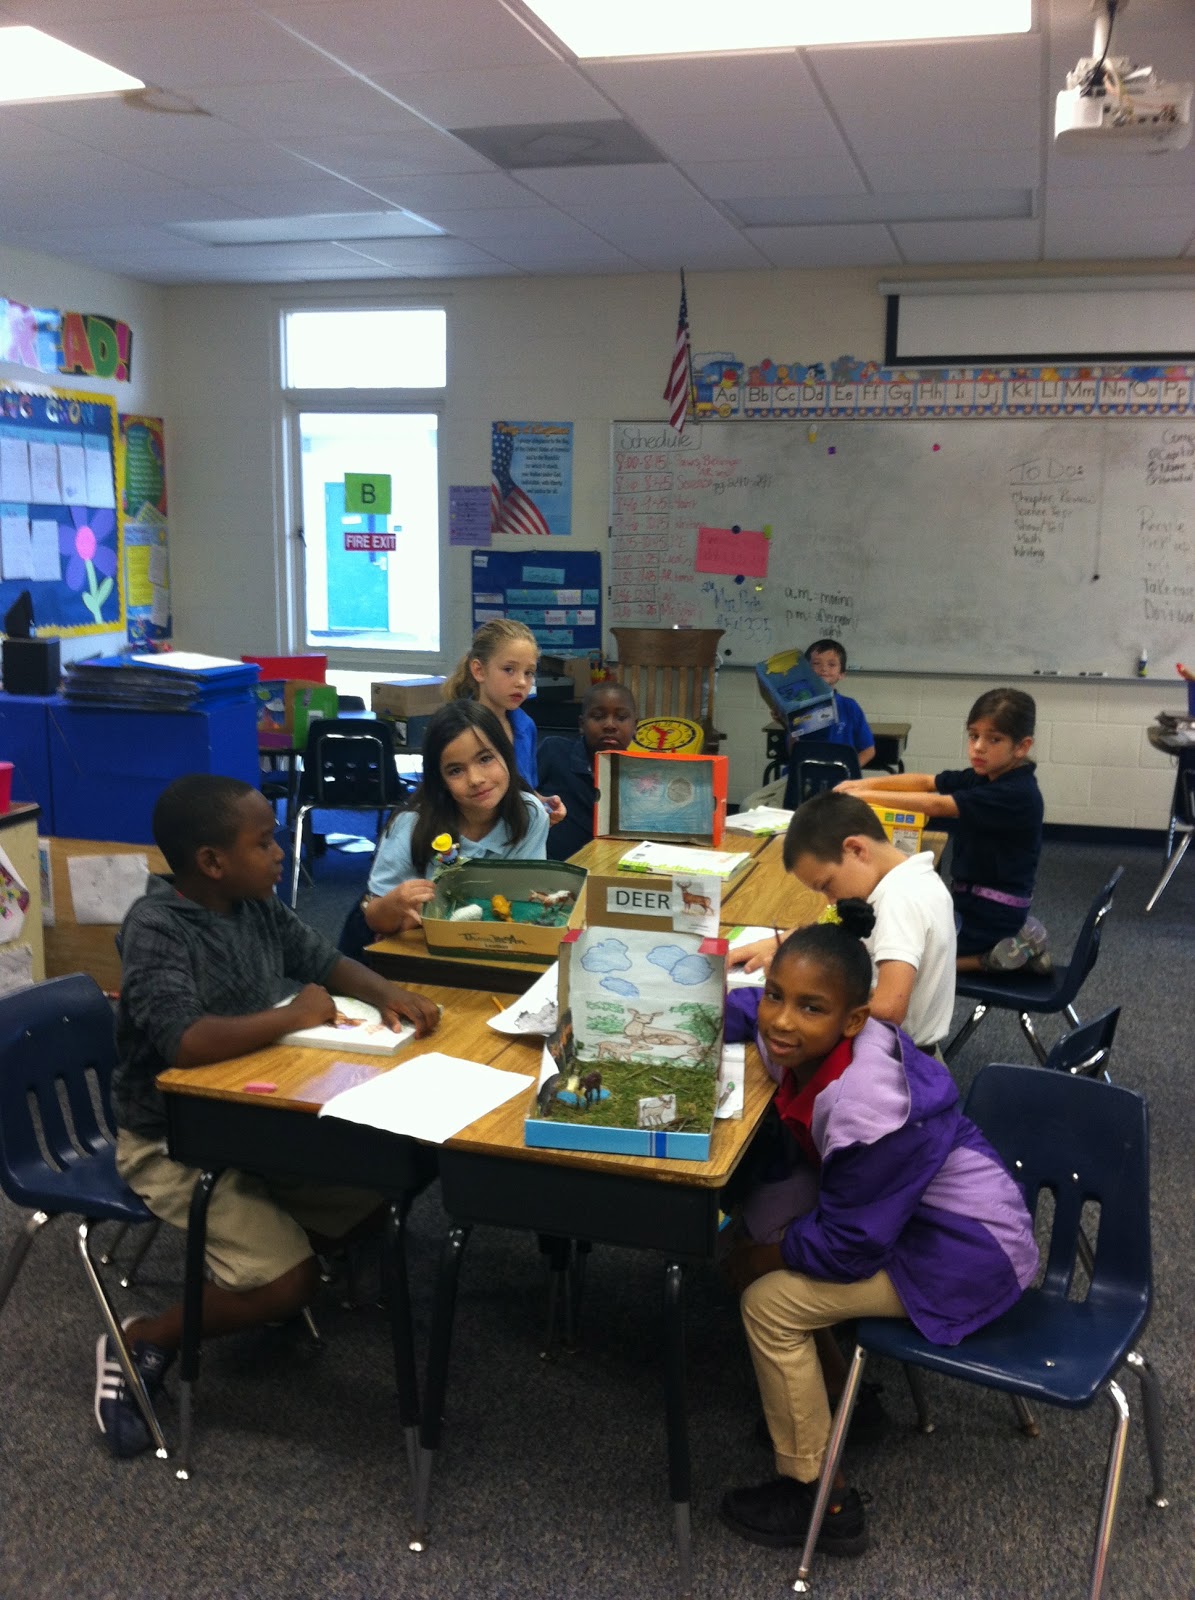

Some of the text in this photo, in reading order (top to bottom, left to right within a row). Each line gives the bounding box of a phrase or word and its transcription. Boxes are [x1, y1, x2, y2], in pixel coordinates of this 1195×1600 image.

[620, 427, 692, 450] Schedule
[1009, 457, 1041, 481] To
[361, 483, 376, 504] B
[346, 535, 396, 548] FIRE EXIT
[615, 890, 670, 910] DEER
